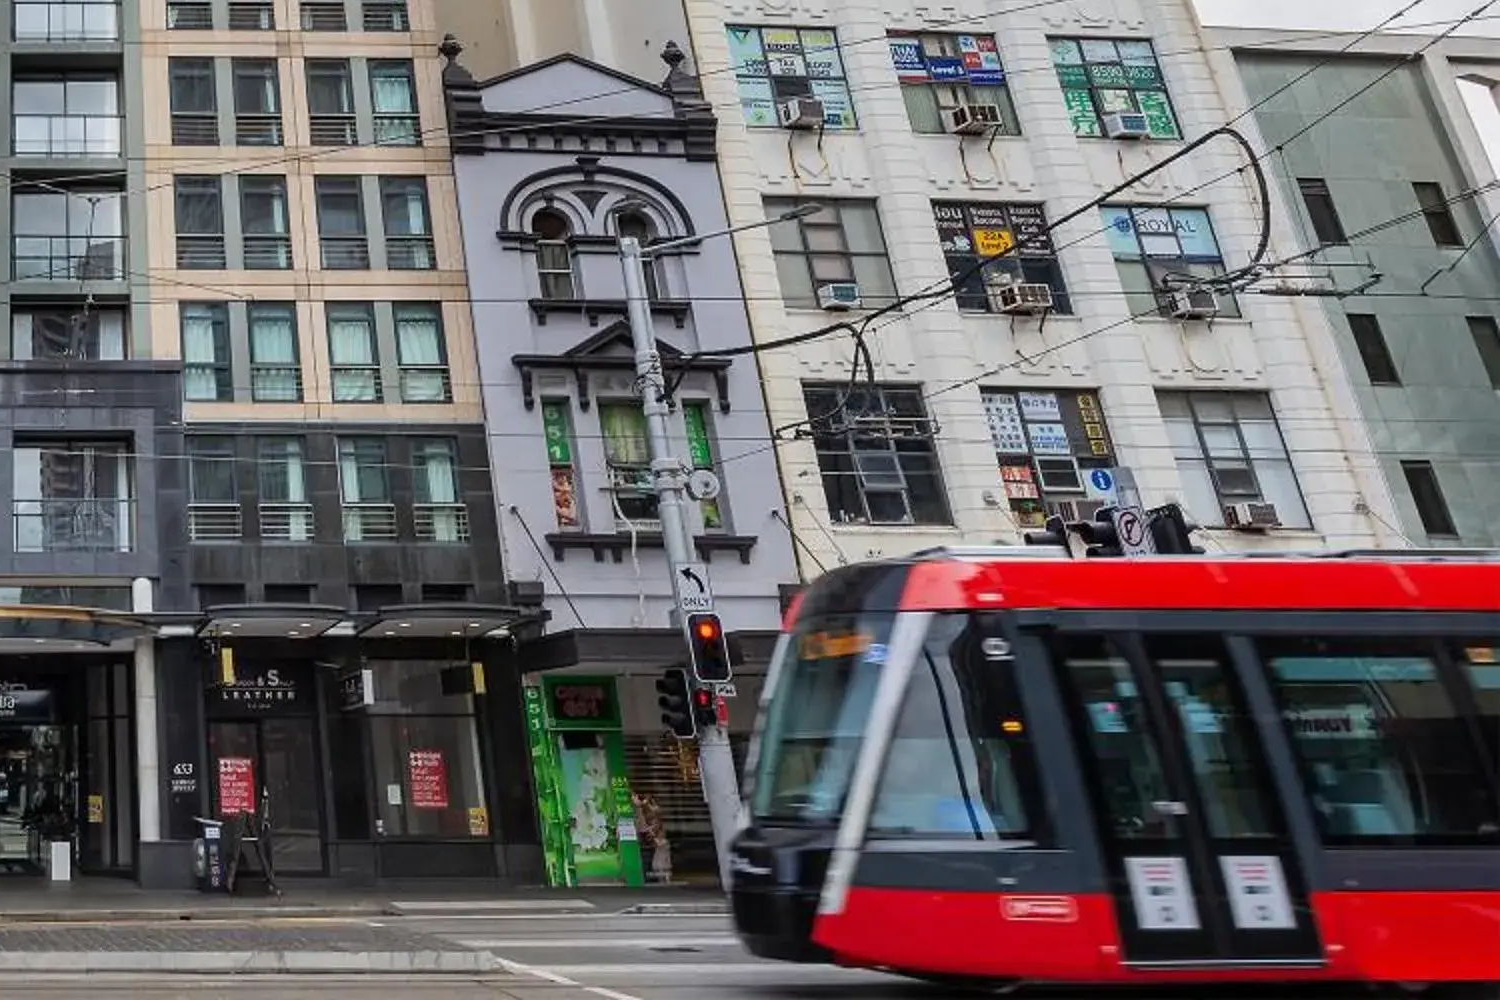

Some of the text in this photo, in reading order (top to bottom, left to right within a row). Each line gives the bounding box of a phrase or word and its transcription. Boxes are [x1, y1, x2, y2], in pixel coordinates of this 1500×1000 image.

[931, 63, 957, 76] Level
[1137, 218, 1197, 233] ROYAL
[684, 597, 709, 608] ONLY
[222, 690, 297, 700] LEATHER
[526, 686, 541, 730] 651
[173, 763, 194, 775] 653
